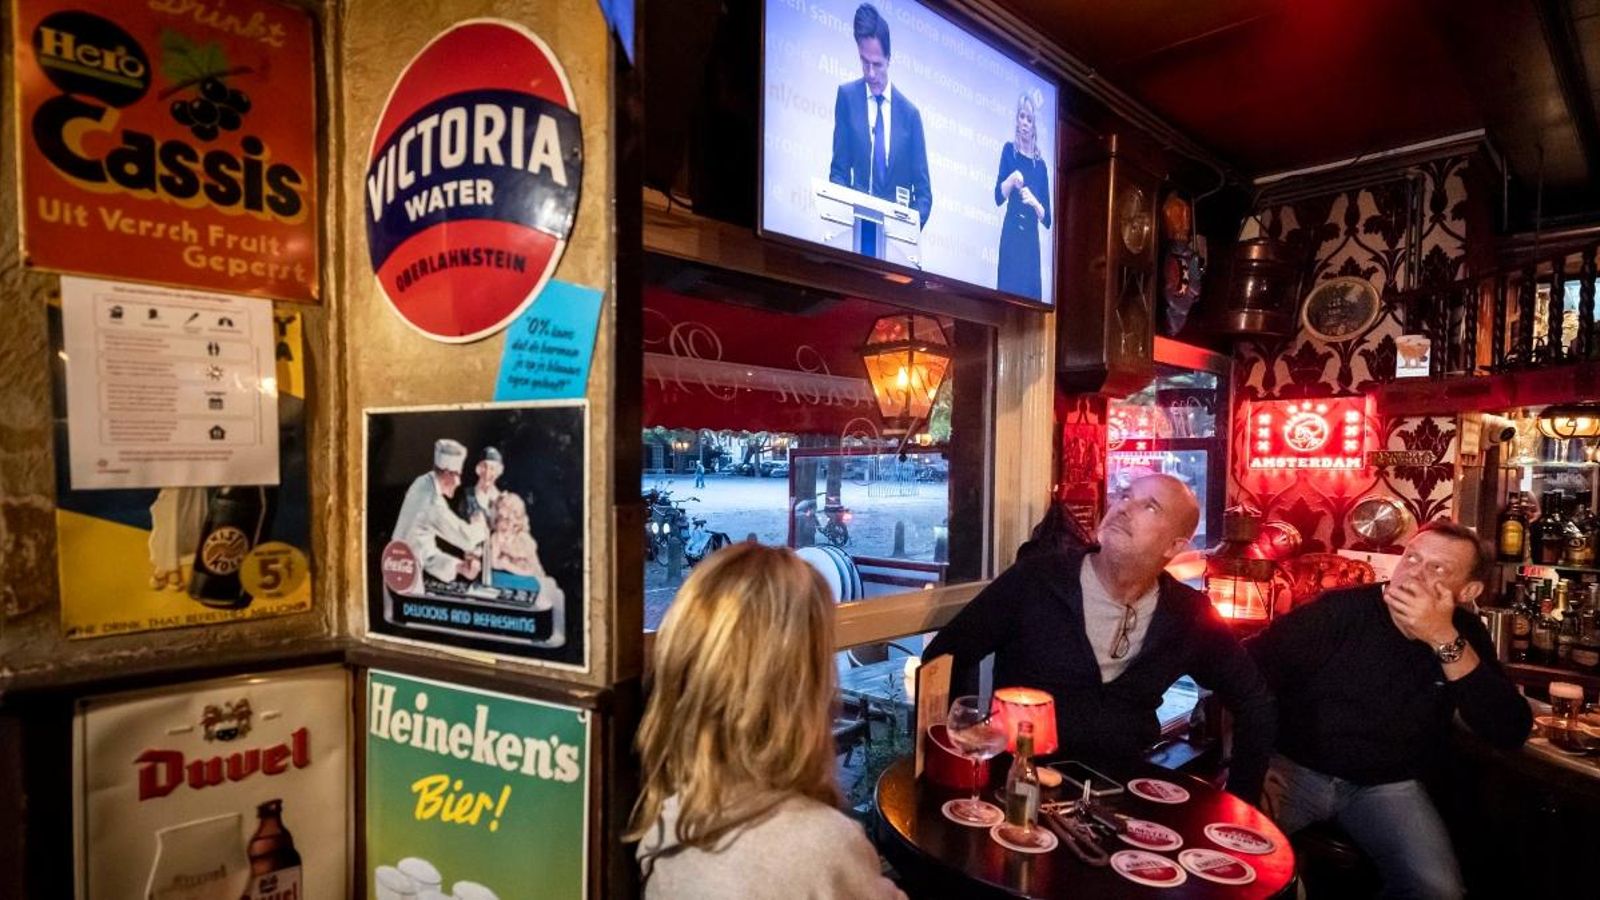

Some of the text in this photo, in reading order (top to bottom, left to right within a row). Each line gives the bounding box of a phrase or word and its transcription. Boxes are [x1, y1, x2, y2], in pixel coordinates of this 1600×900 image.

[810, 5, 853, 32] same
[40, 26, 146, 78] Hero
[32, 94, 305, 220] Cassis
[367, 103, 568, 223] VICTORIA
[404, 178, 494, 222] WATER
[38, 196, 280, 256] Uit Versch Fruit
[183, 245, 306, 282] Geperst
[396, 246, 527, 293] OBERLAHNSTEIN
[1250, 456, 1362, 469] AMSTERDAM
[102, 619, 140, 633] DRINK
[149, 614, 179, 627] THAT
[403, 603, 536, 633] DELICIOUS AND REFRESHING
[370, 682, 581, 784] Heineken's
[132, 726, 312, 802] Duvel
[411, 774, 513, 832] Bier!
